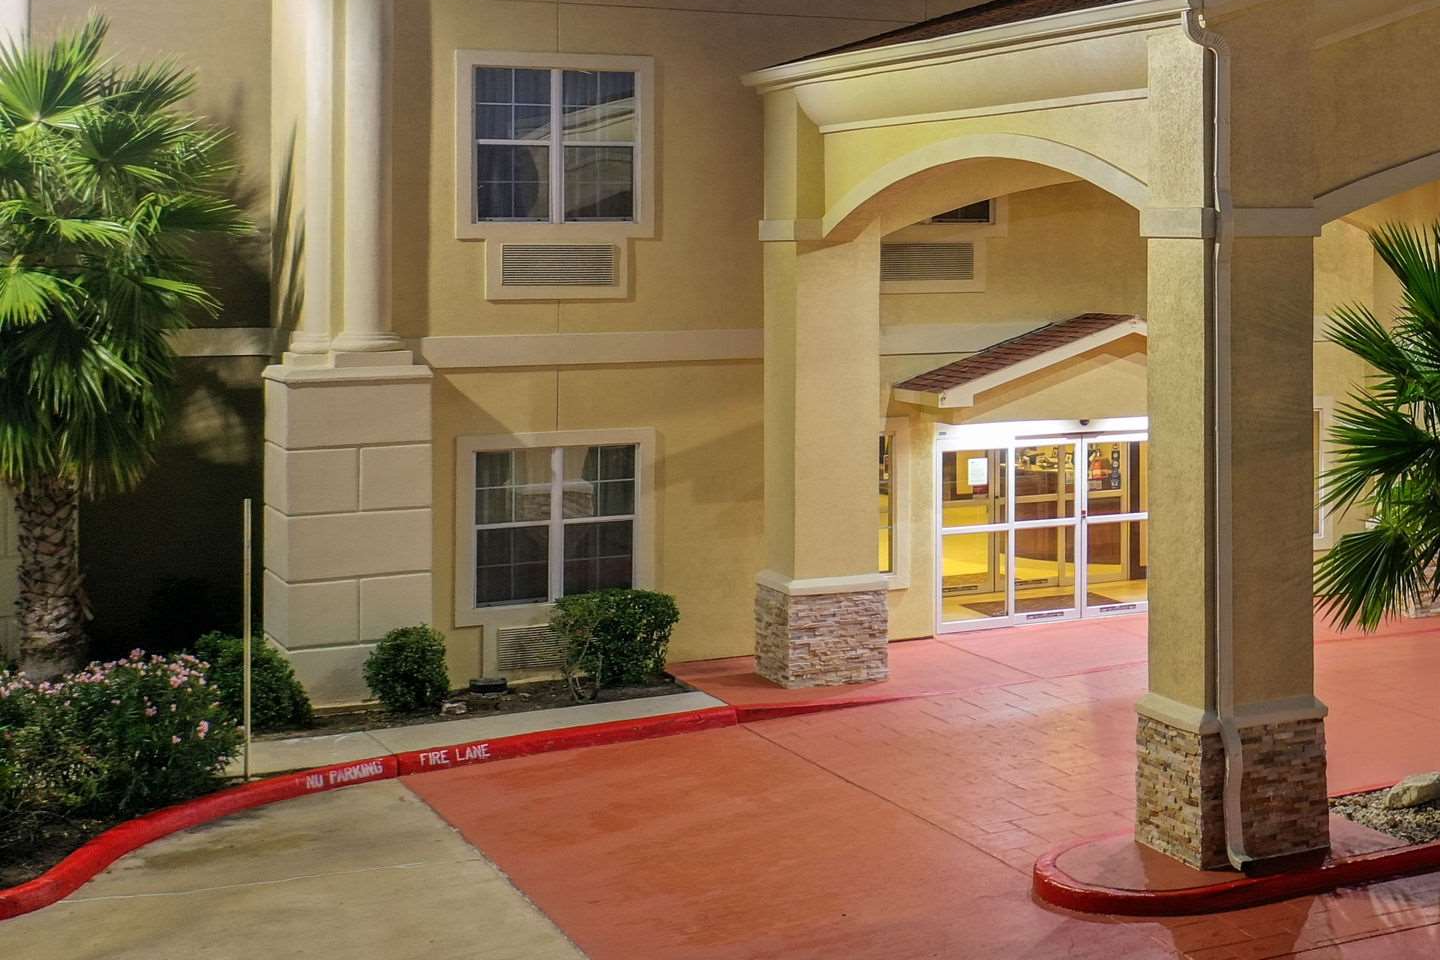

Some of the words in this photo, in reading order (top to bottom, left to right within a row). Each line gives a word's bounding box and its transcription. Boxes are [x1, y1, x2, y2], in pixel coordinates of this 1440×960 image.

[419, 749, 450, 767] FIRE
[455, 743, 490, 762] LANE
[329, 758, 384, 785] PARKING
